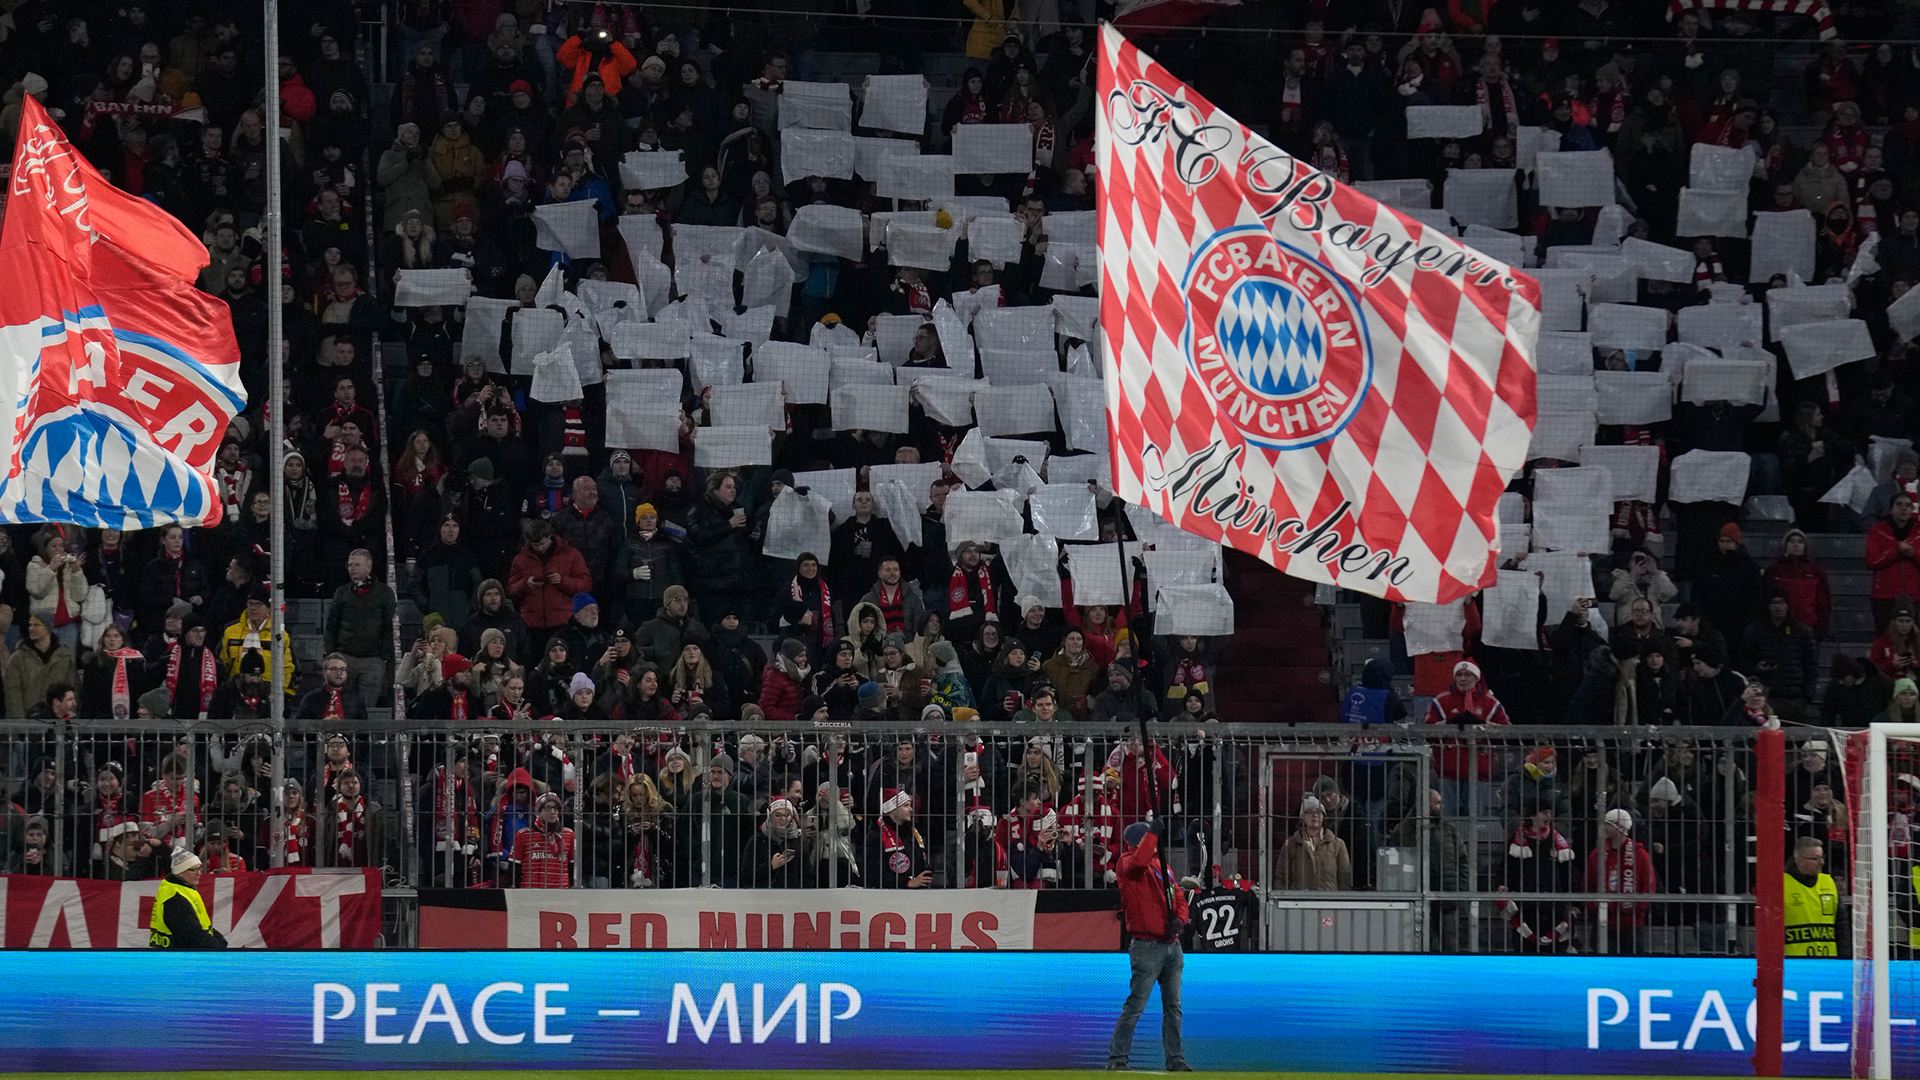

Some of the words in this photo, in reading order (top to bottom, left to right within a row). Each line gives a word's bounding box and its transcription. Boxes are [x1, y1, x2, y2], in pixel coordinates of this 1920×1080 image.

[1202, 904, 1239, 940] 22
[314, 983, 574, 1046] PEACE
[667, 983, 862, 1045] МИР
